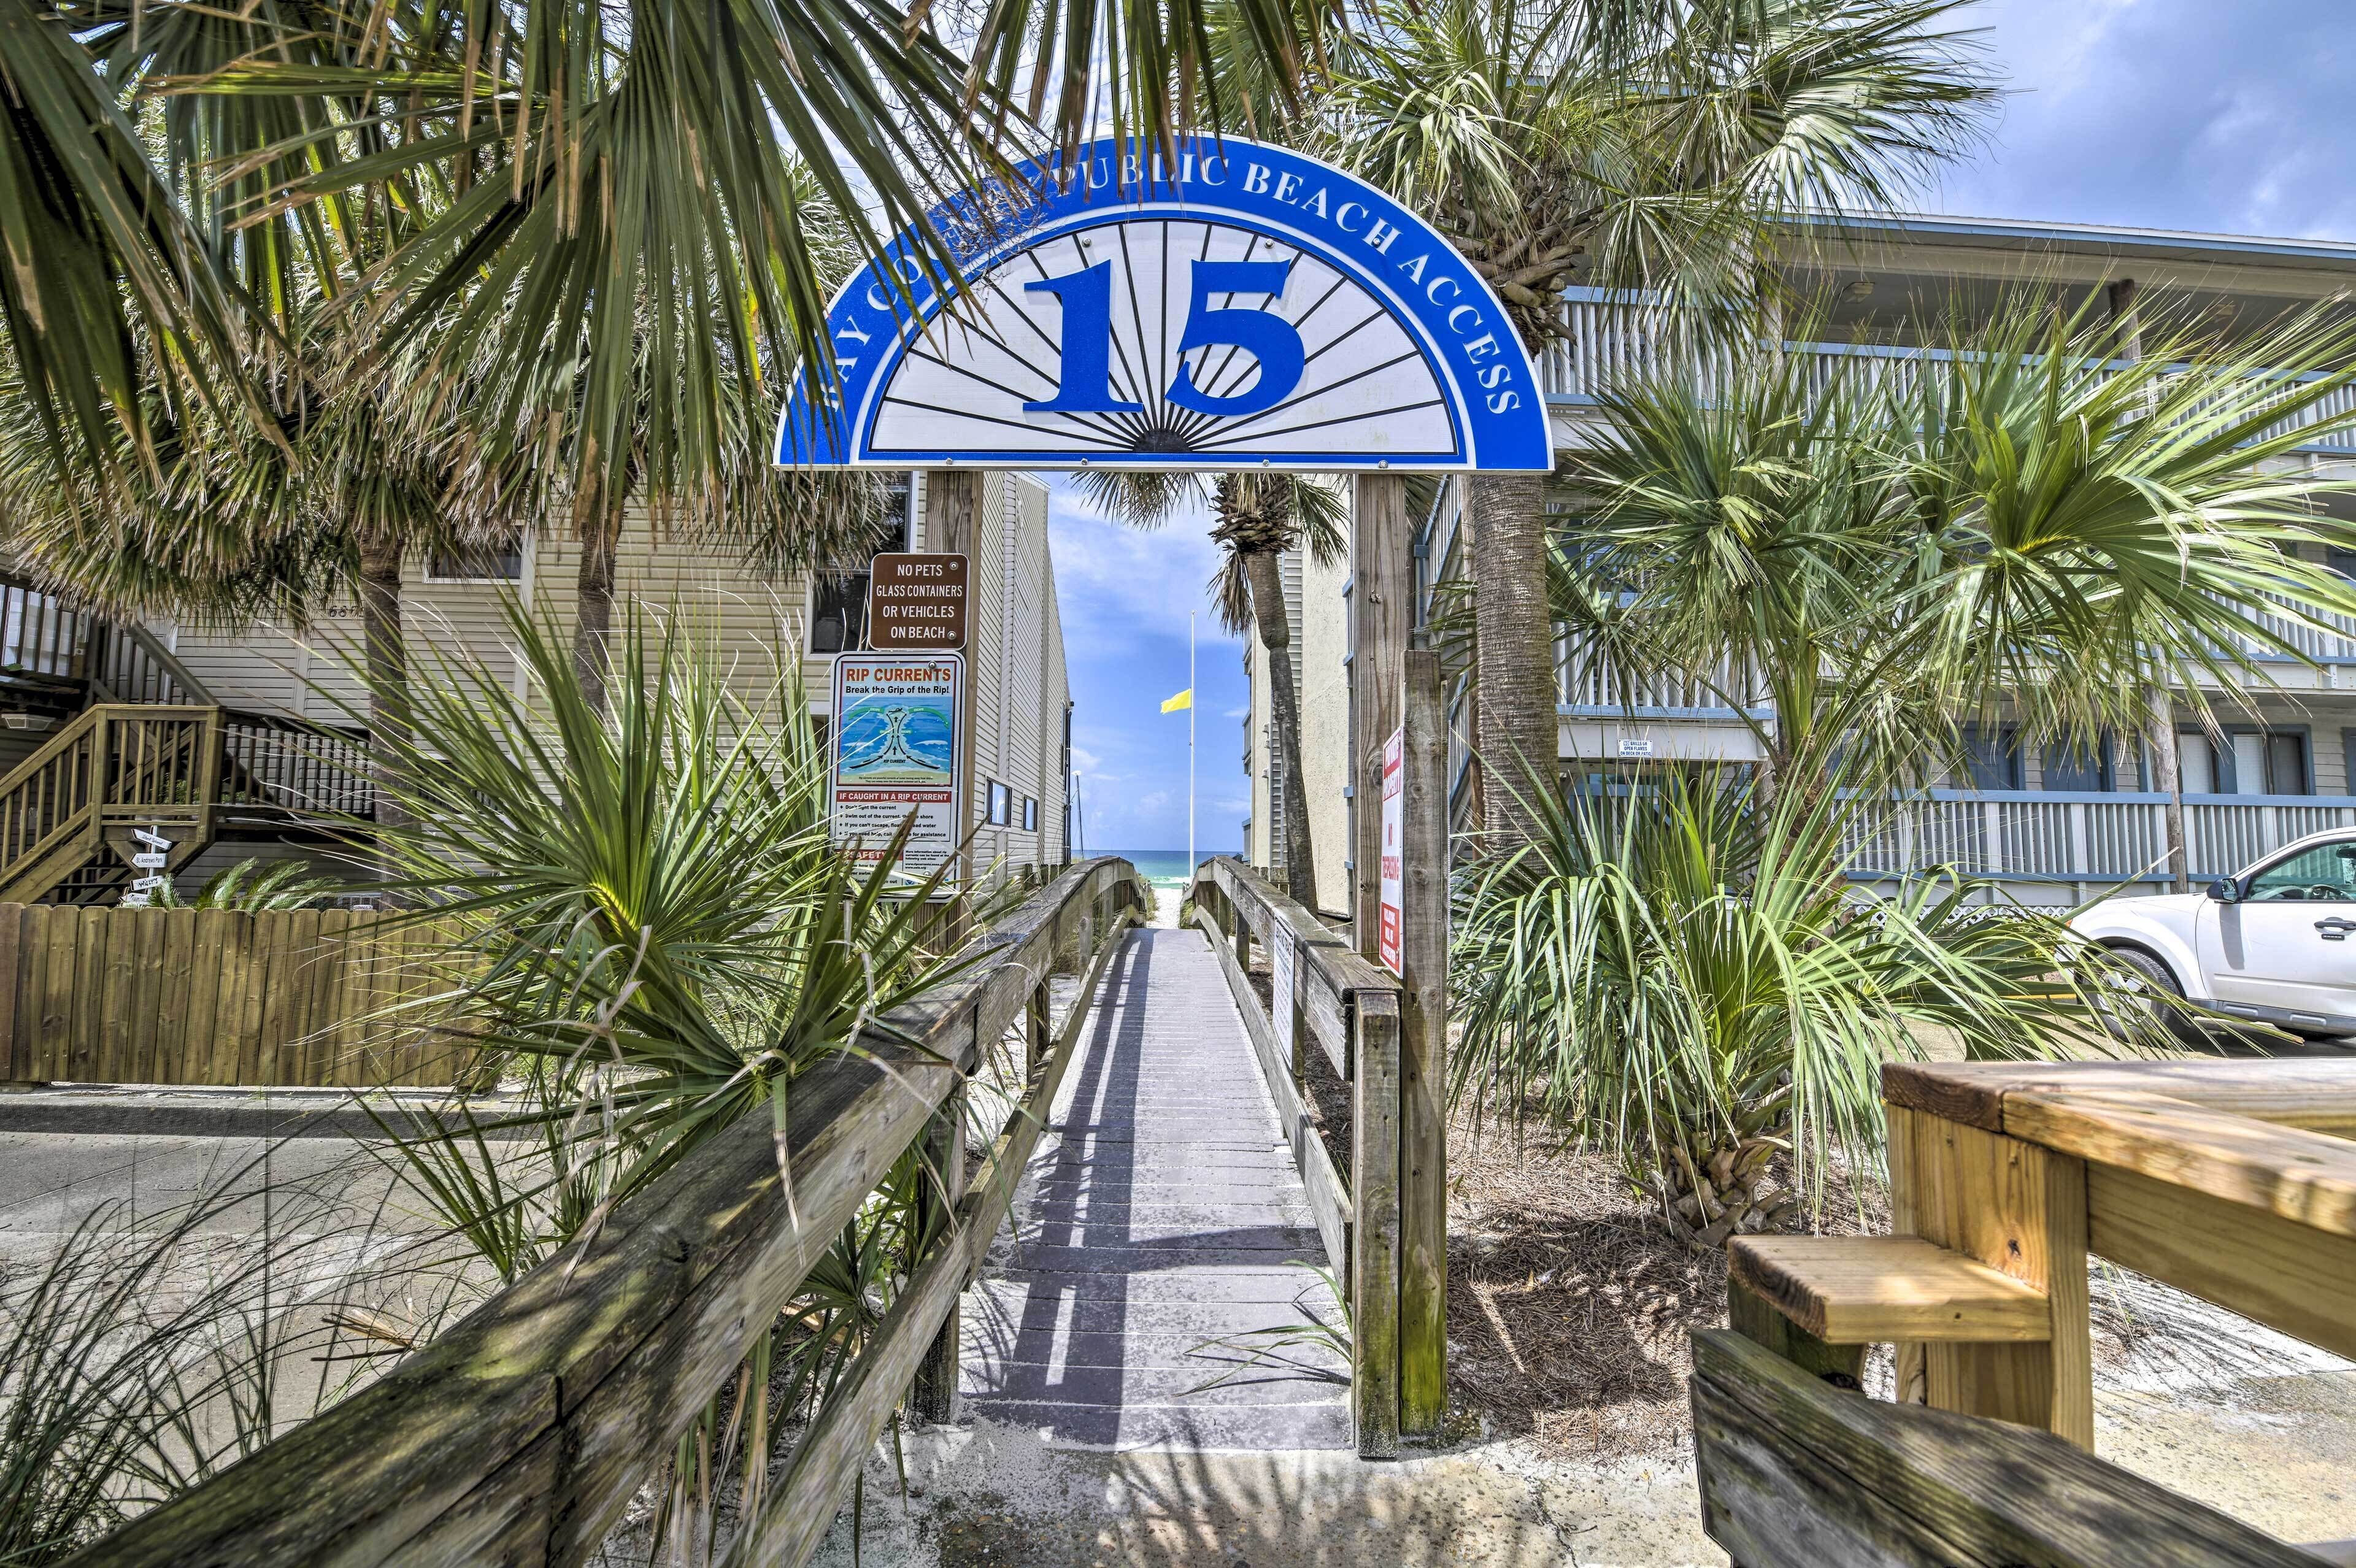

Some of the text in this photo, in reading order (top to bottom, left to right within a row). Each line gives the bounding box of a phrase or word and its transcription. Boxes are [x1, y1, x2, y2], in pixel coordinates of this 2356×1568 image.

[867, 177, 1037, 311] CONY
[1051, 153, 1229, 197] PUBLIC
[1242, 161, 1403, 256] BEACH
[1398, 253, 1522, 415] ACCESS
[1023, 258, 1306, 416] 15
[898, 564, 942, 576] NO PETS
[876, 585, 963, 597] GLASS CONTAINERS
[882, 605, 955, 618] OR VEHICLES
[891, 626, 945, 639] ON BEACH
[846, 668, 951, 682] RIP CURRENTS
[888, 686, 904, 694] Grip
[933, 686, 949, 694] Rip!
